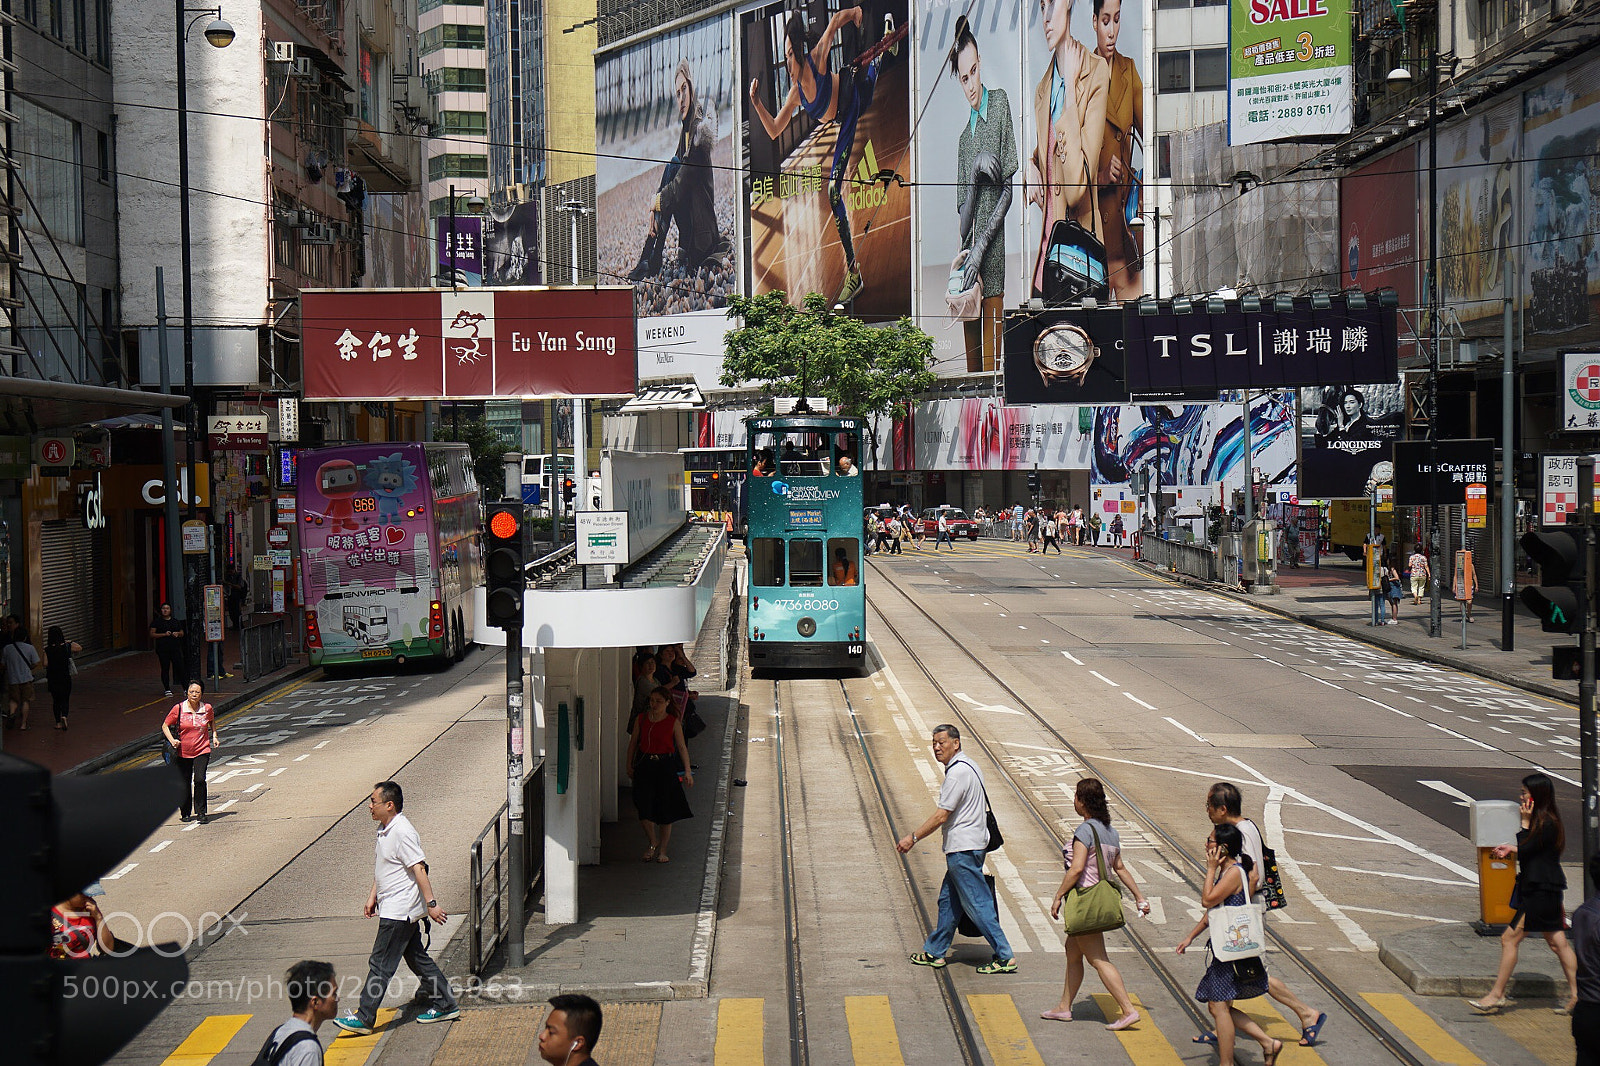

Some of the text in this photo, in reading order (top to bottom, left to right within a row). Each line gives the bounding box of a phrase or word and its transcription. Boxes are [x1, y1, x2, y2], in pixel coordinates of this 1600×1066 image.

[1277, 106, 1303, 119] 2889
[1306, 103, 1332, 116] 8761
[752, 176, 774, 204] 自信
[847, 186, 888, 212] adidas
[645, 325, 685, 340] WEEKEND
[334, 328, 420, 361] 余仁生
[512, 330, 617, 356] Eu Yan Sang
[1153, 326, 1369, 358] TSL 謝瑞麟
[757, 420, 855, 428] 140 140
[1327, 440, 1382, 450] LONGINES
[1548, 458, 1575, 470] 政府
[1548, 475, 1575, 488] 認可
[791, 490, 841, 499] GRANDVIEW
[354, 498, 376, 512] 968
[327, 526, 381, 550] 服務乘客
[344, 589, 386, 599] ENVIRO
[775, 600, 839, 611] 2736 8080
[848, 645, 862, 654] 140
